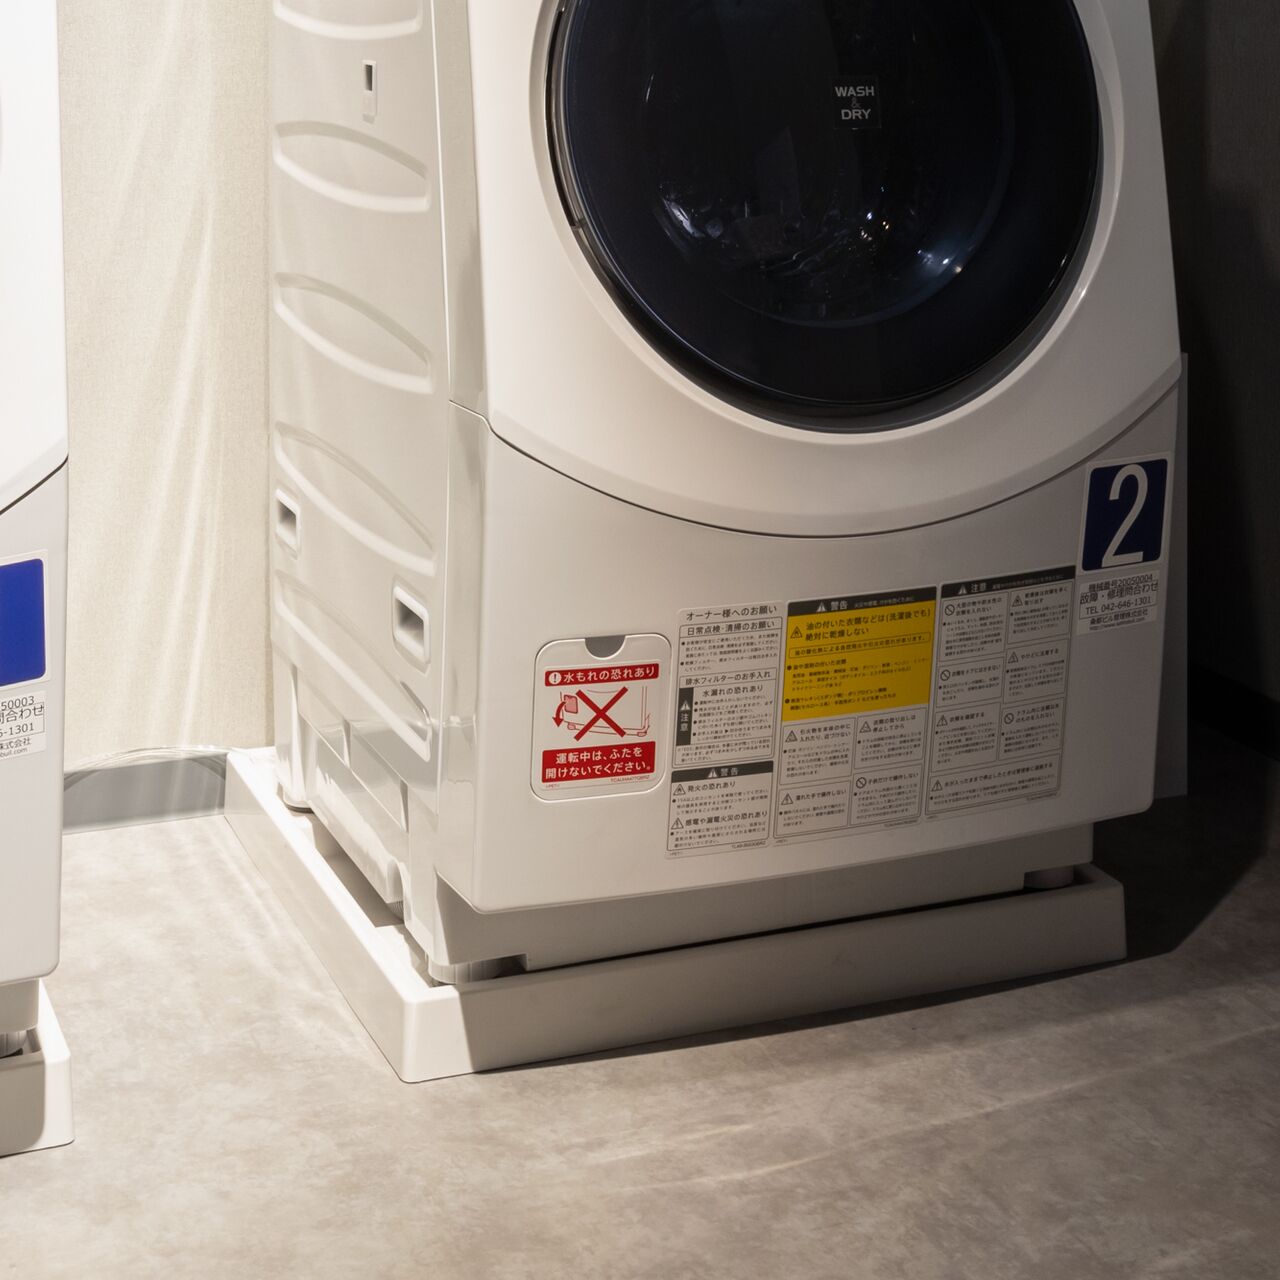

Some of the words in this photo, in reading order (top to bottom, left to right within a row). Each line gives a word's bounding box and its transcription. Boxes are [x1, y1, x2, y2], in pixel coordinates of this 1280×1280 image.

[834, 86, 875, 97] WASH
[841, 108, 871, 120] DRY
[1101, 463, 1148, 568] 2
[686, 605, 778, 621] オーナー様へのお願い
[1085, 605, 1099, 616] TEL
[1100, 596, 1152, 613] 042-646-1301
[563, 668, 655, 683] 水もれの恐れあり
[555, 746, 643, 765] 運転中は、ふたを
[545, 761, 651, 779] 開けないでください。
